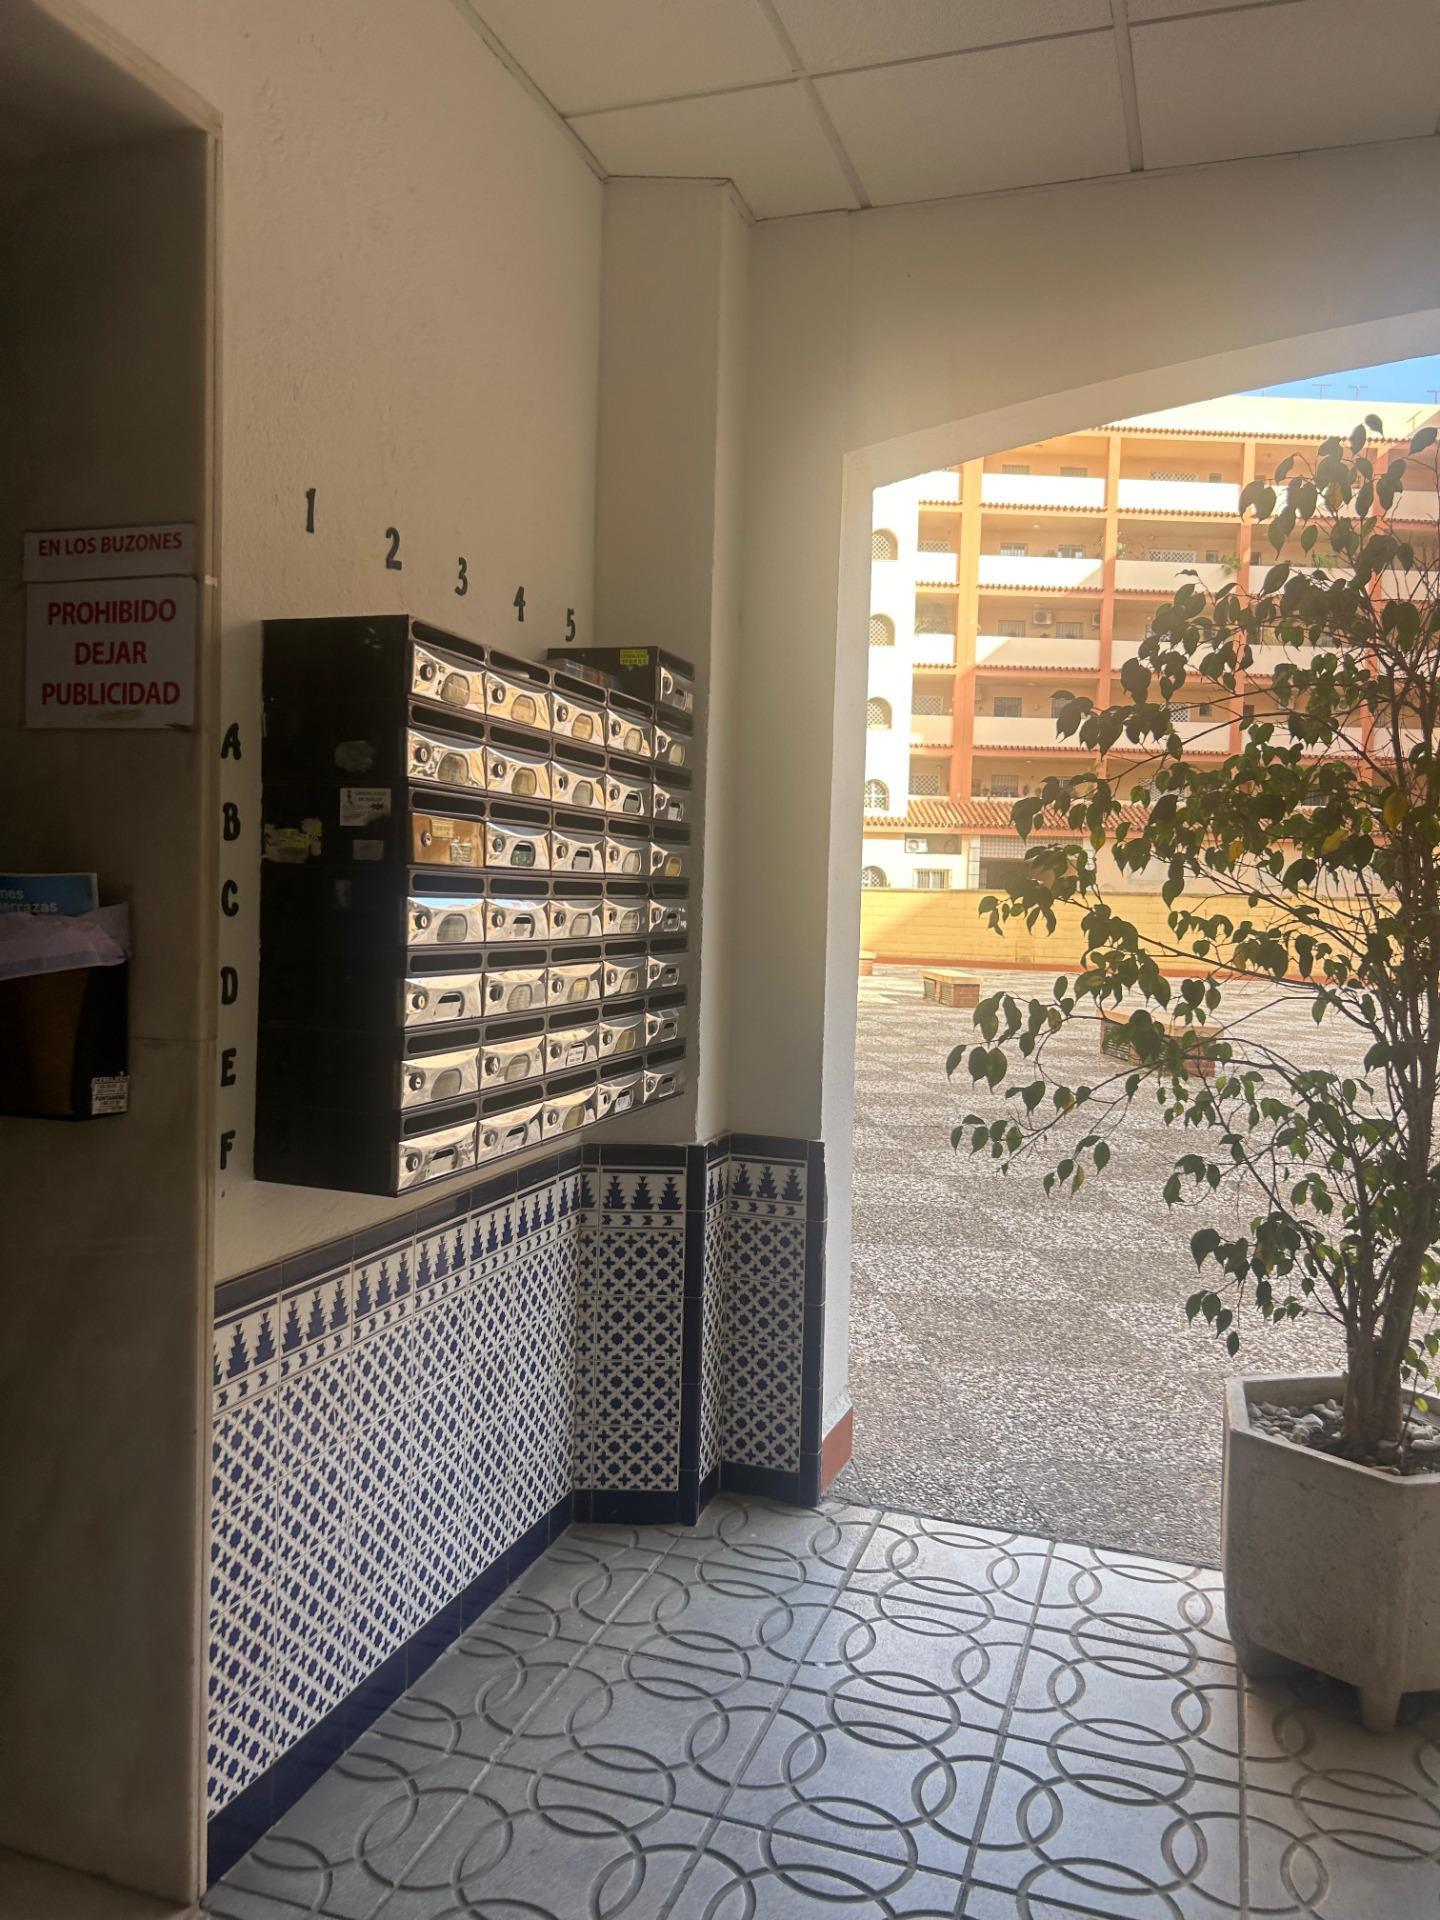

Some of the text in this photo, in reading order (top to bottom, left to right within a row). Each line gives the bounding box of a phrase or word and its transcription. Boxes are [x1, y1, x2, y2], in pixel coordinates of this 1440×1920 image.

[38, 532, 183, 556] EN LOS BUZONES
[305, 487, 576, 642] 1 2 3 4 5
[48, 598, 176, 625] PROHIBIDO
[74, 641, 147, 665] DEJAR
[42, 682, 181, 705] PUBLICIDAD
[221, 722, 242, 760] A
[222, 802, 241, 841] B
[221, 879, 239, 917] C
[220, 966, 239, 1005] D
[220, 1048, 237, 1087] E
[220, 1130, 236, 1170] F
